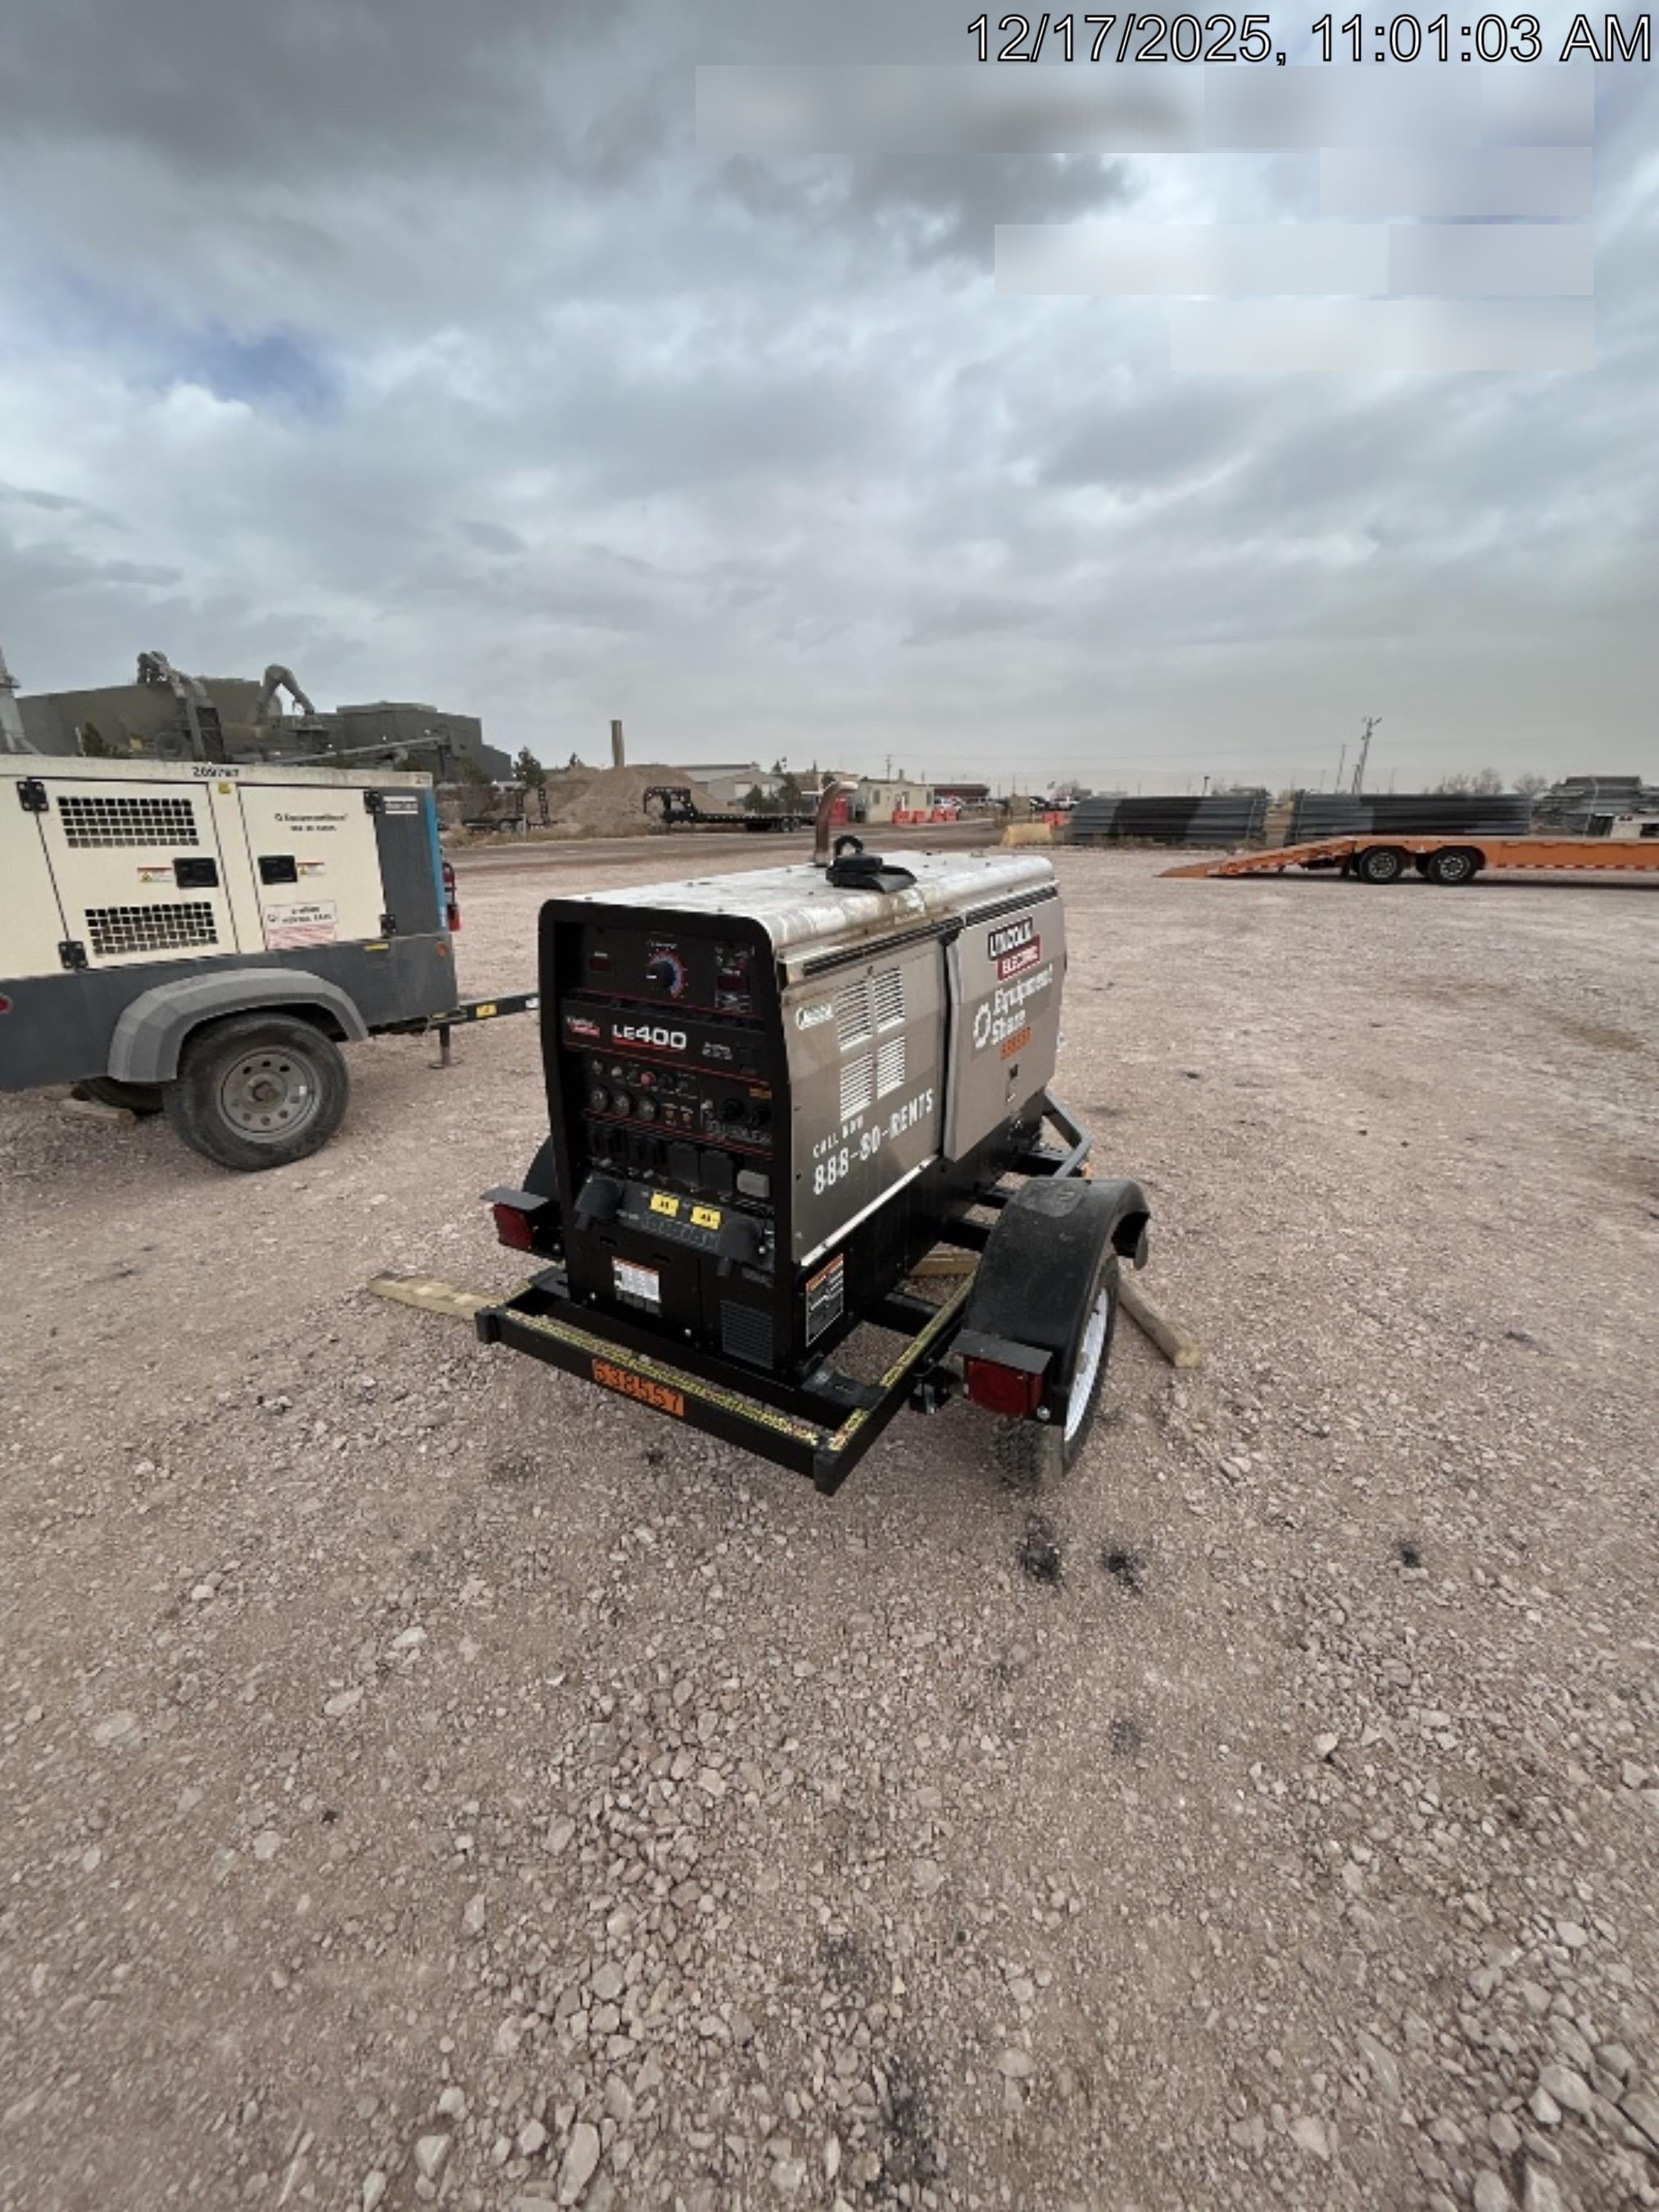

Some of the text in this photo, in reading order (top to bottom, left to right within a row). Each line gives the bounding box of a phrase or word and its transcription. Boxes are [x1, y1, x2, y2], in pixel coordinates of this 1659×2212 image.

[993, 963, 1053, 1015] Equipment
[613, 1024, 687, 1050] LE400
[991, 1009, 1026, 1045] Share
[813, 1088, 933, 1195] 888-80-RENTS
[813, 1133, 839, 1158] CALL
